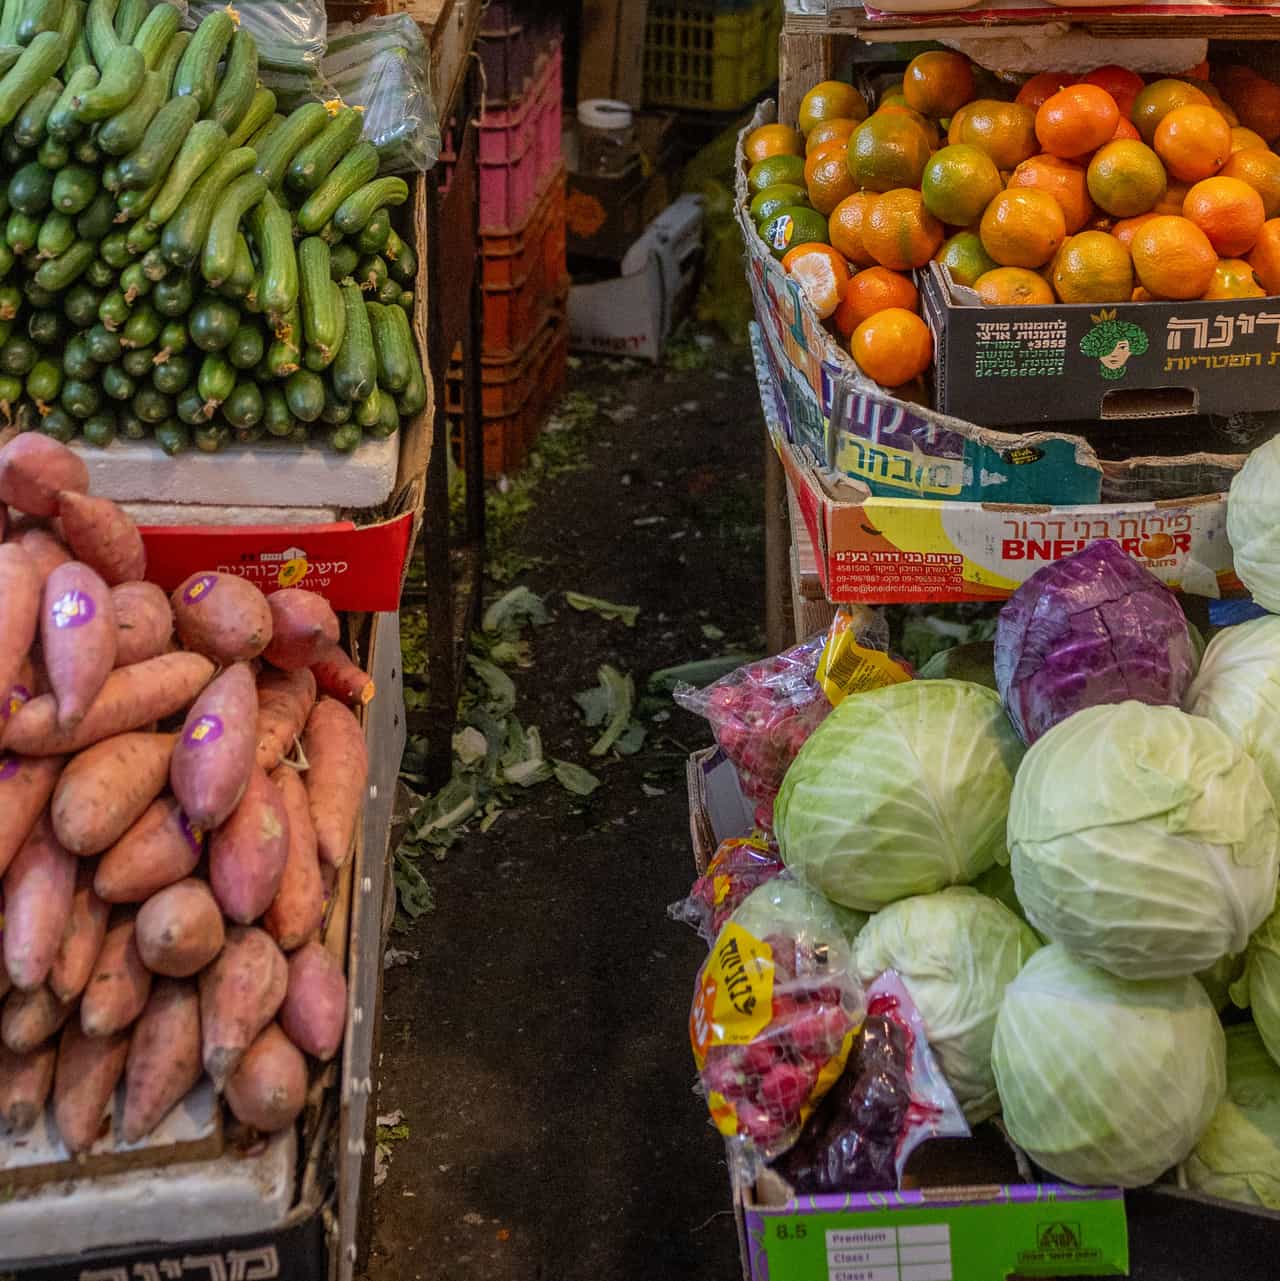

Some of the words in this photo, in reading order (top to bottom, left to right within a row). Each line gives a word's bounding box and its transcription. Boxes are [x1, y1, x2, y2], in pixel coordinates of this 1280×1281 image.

[1016, 330, 1067, 340] הזמנות
[1163, 352, 1262, 372] הפטריות
[1004, 521, 1067, 540] דרור
[1072, 521, 1110, 540] בני
[1120, 514, 1192, 538] פירות
[872, 552, 899, 562] דרור
[904, 553, 923, 562] בני
[926, 553, 962, 563] פירות
[776, 1223, 808, 1240] 8.5
[832, 1231, 887, 1244] Premium
[833, 1252, 864, 1264] Class
[835, 1271, 866, 1281] Class
